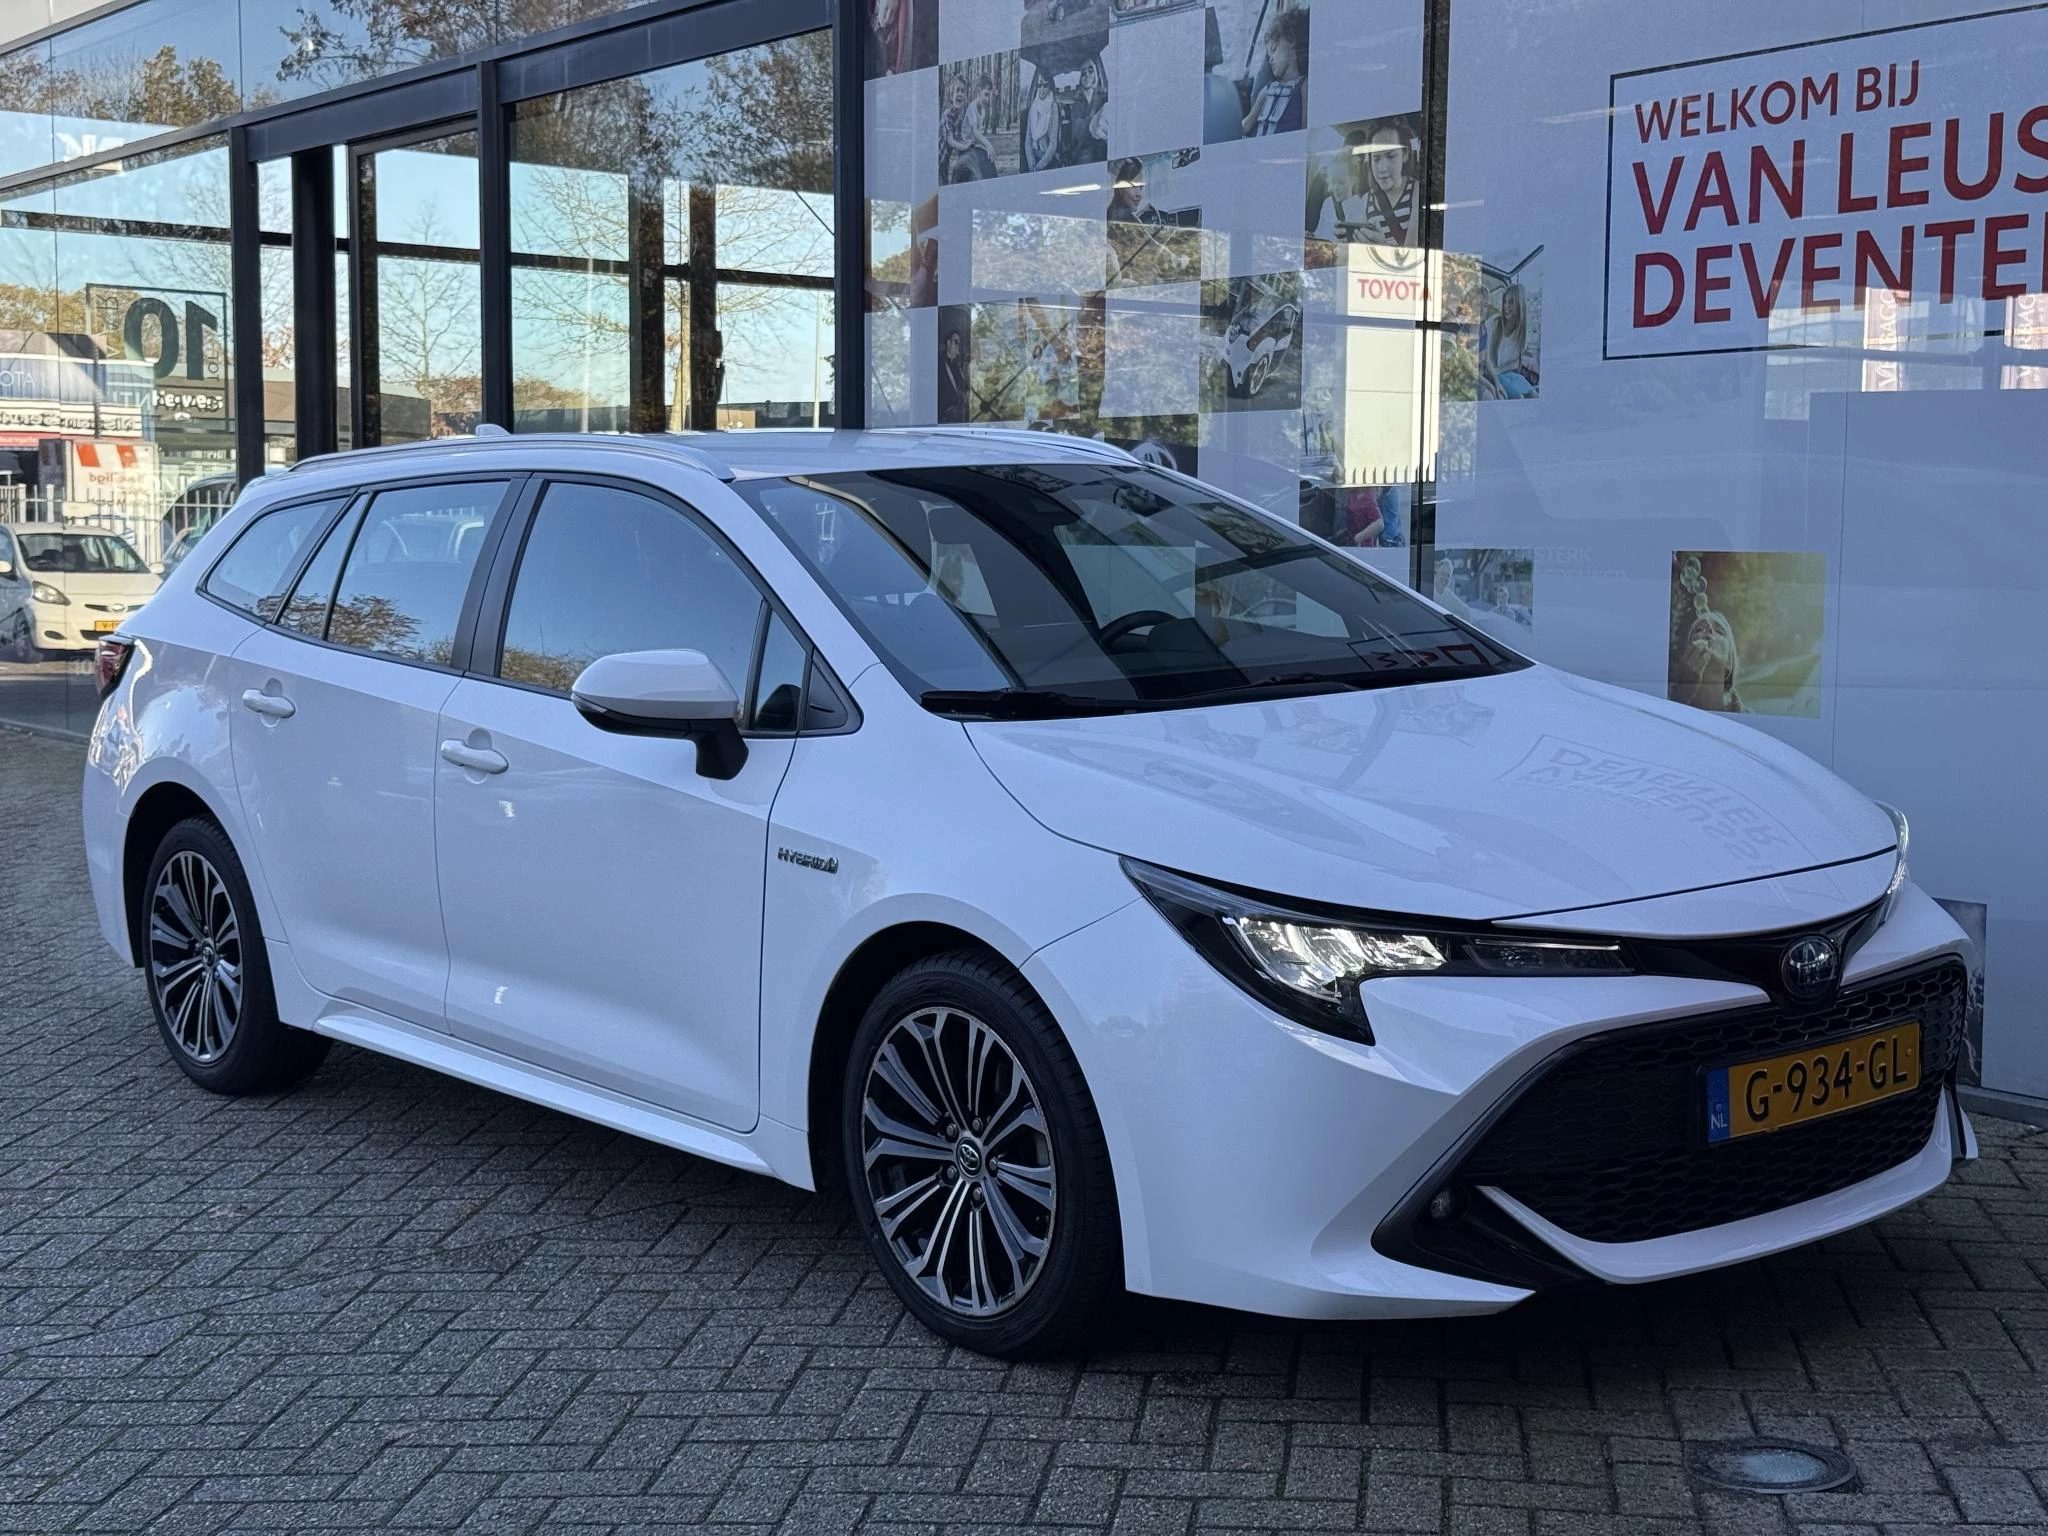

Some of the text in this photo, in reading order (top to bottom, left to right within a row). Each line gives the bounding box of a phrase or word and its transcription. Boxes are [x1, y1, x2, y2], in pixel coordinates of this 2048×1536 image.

[1635, 59, 1920, 144] WELKOM BIJ
[1632, 104, 2048, 235] VAN LEUS
[1357, 278, 1432, 302] TOYOTA
[1633, 211, 2048, 329] DEVENTE
[1710, 1112, 1728, 1130] NL
[1745, 1035, 1908, 1122] G-934-GL
